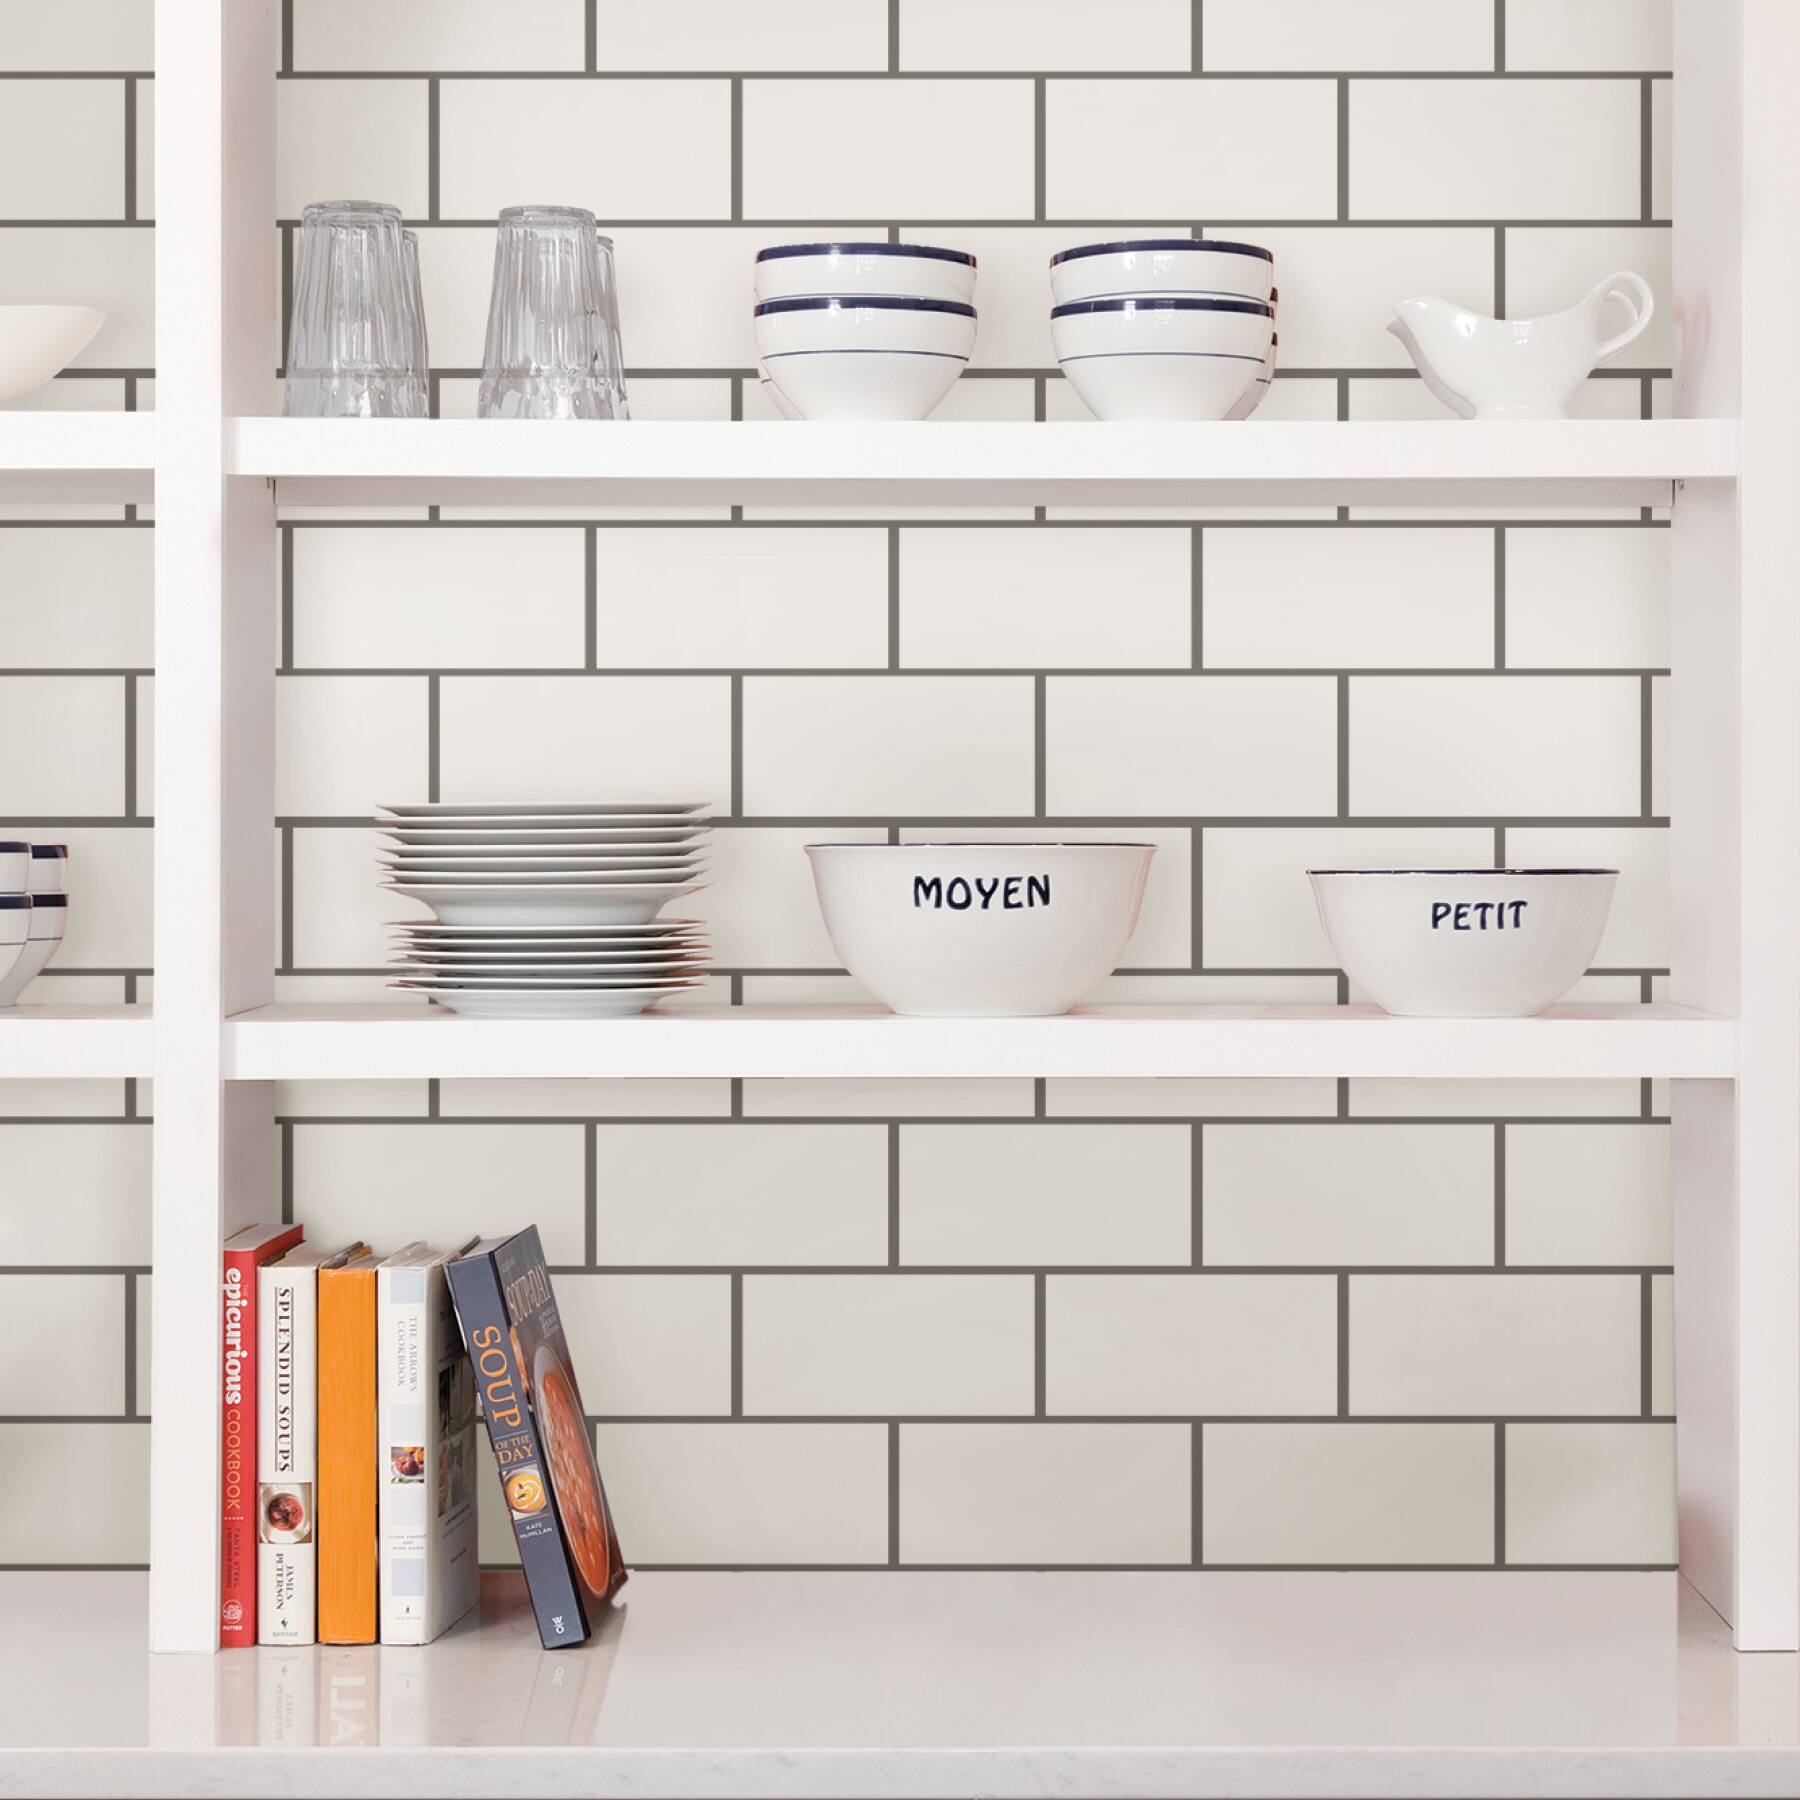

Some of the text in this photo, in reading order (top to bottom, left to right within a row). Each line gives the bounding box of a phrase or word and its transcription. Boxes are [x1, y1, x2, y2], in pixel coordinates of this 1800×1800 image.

[914, 874, 1050, 910] MOYEN
[1431, 899, 1528, 931] PETIT
[278, 1287, 290, 1472] SPLENDID SOUPS
[397, 1321, 406, 1386] COOKBOOK
[409, 1316, 417, 1392] THE ARROWS
[471, 1325, 521, 1428] SOUP
[224, 1267, 248, 1509] epicurious COOKBOOK
[496, 1434, 531, 1453] OF THE
[497, 1443, 534, 1465] DAY
[276, 1553, 284, 1609] PETERSON
[286, 1565, 294, 1600] JAMES
